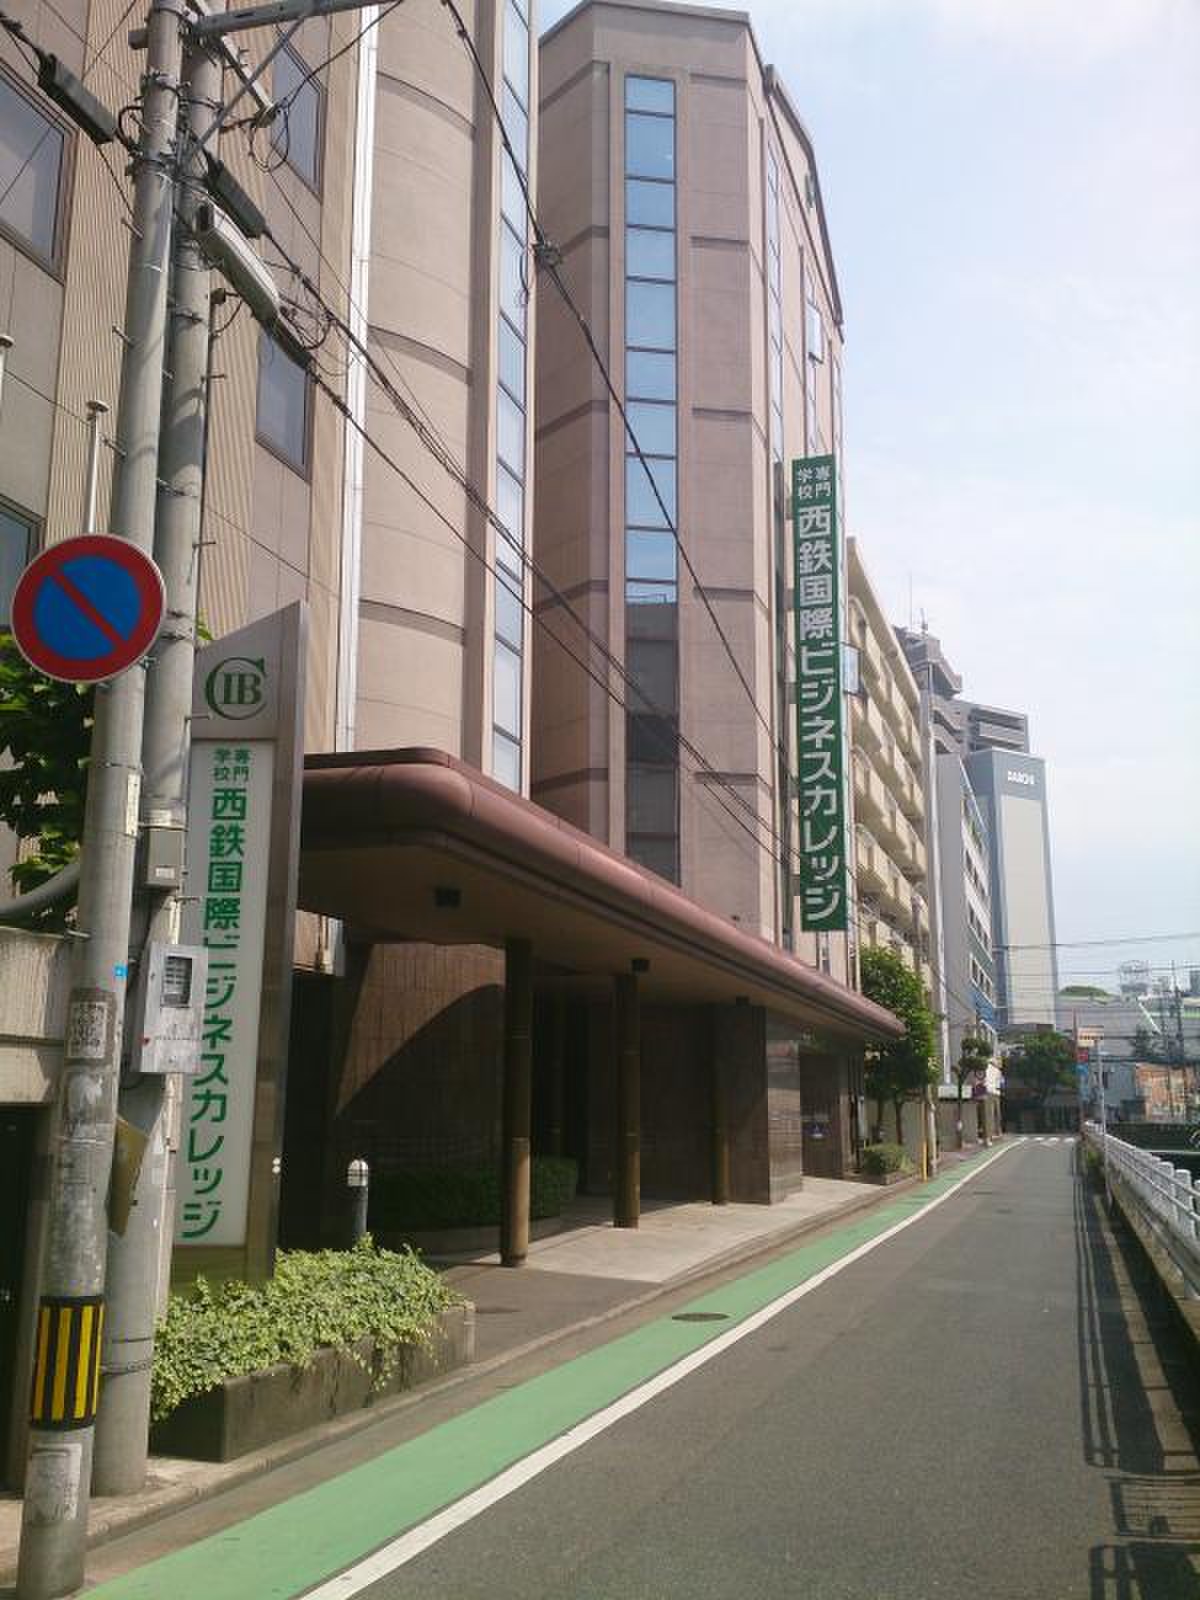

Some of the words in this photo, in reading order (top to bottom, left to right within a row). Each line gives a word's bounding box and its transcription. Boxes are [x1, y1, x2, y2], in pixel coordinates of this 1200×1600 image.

[798, 503, 840, 922] 西鉄国際ビジネスカレッジ
